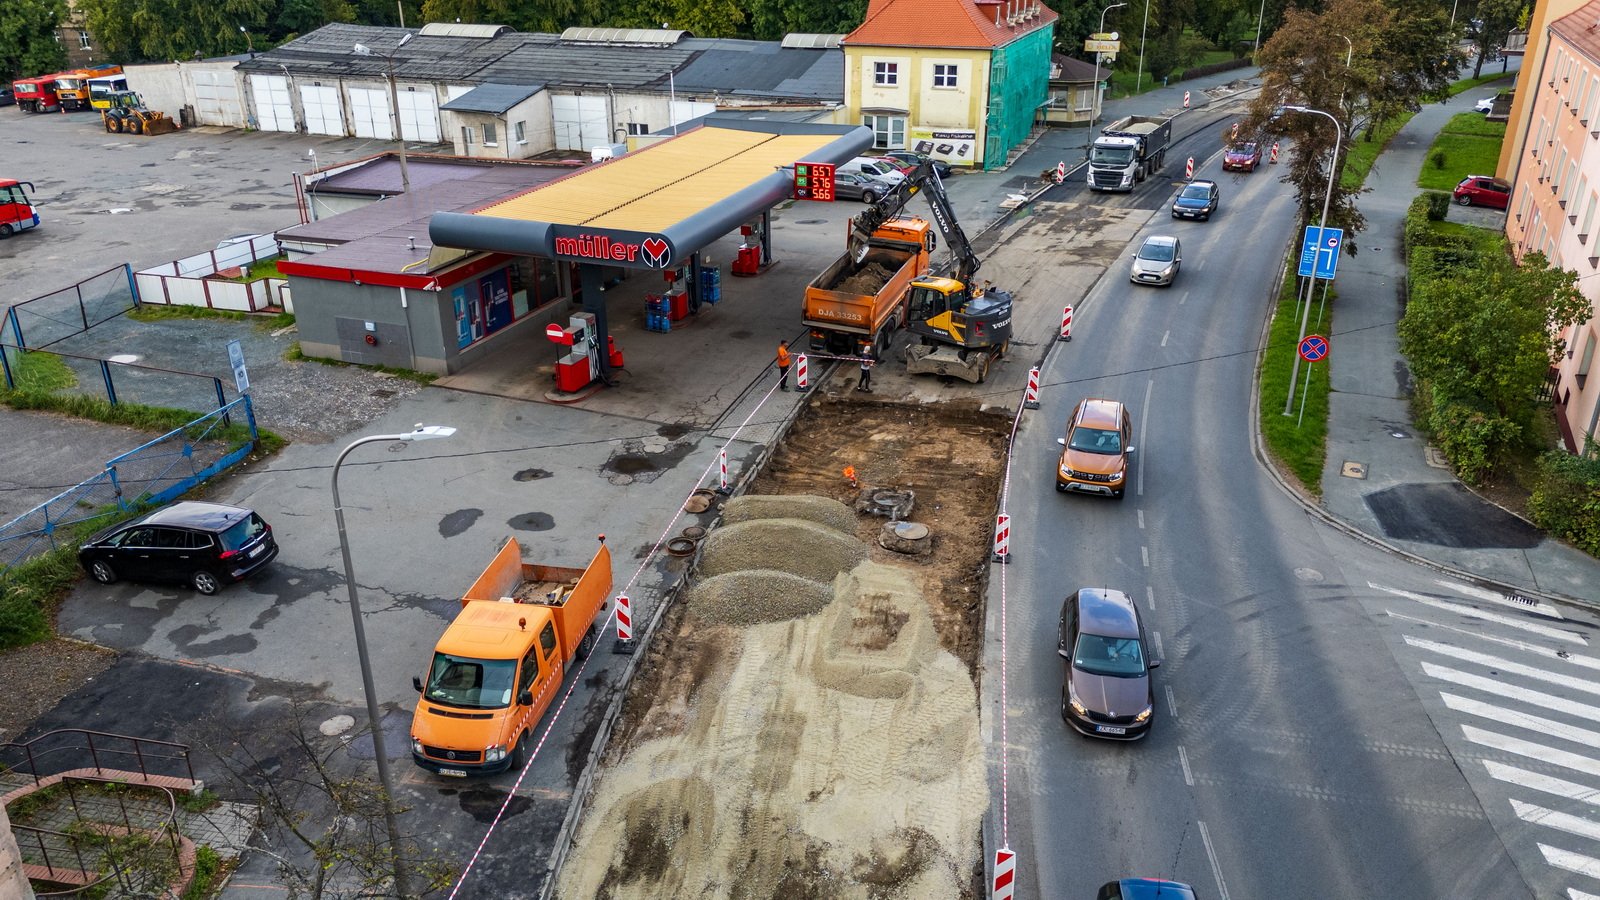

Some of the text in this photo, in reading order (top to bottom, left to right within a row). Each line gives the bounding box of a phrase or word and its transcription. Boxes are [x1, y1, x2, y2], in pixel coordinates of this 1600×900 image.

[932, 201, 949, 233] VOLVO
[555, 234, 640, 262] müller
[818, 308, 862, 321] DJA 33253
[933, 328, 949, 336] VOLVO
